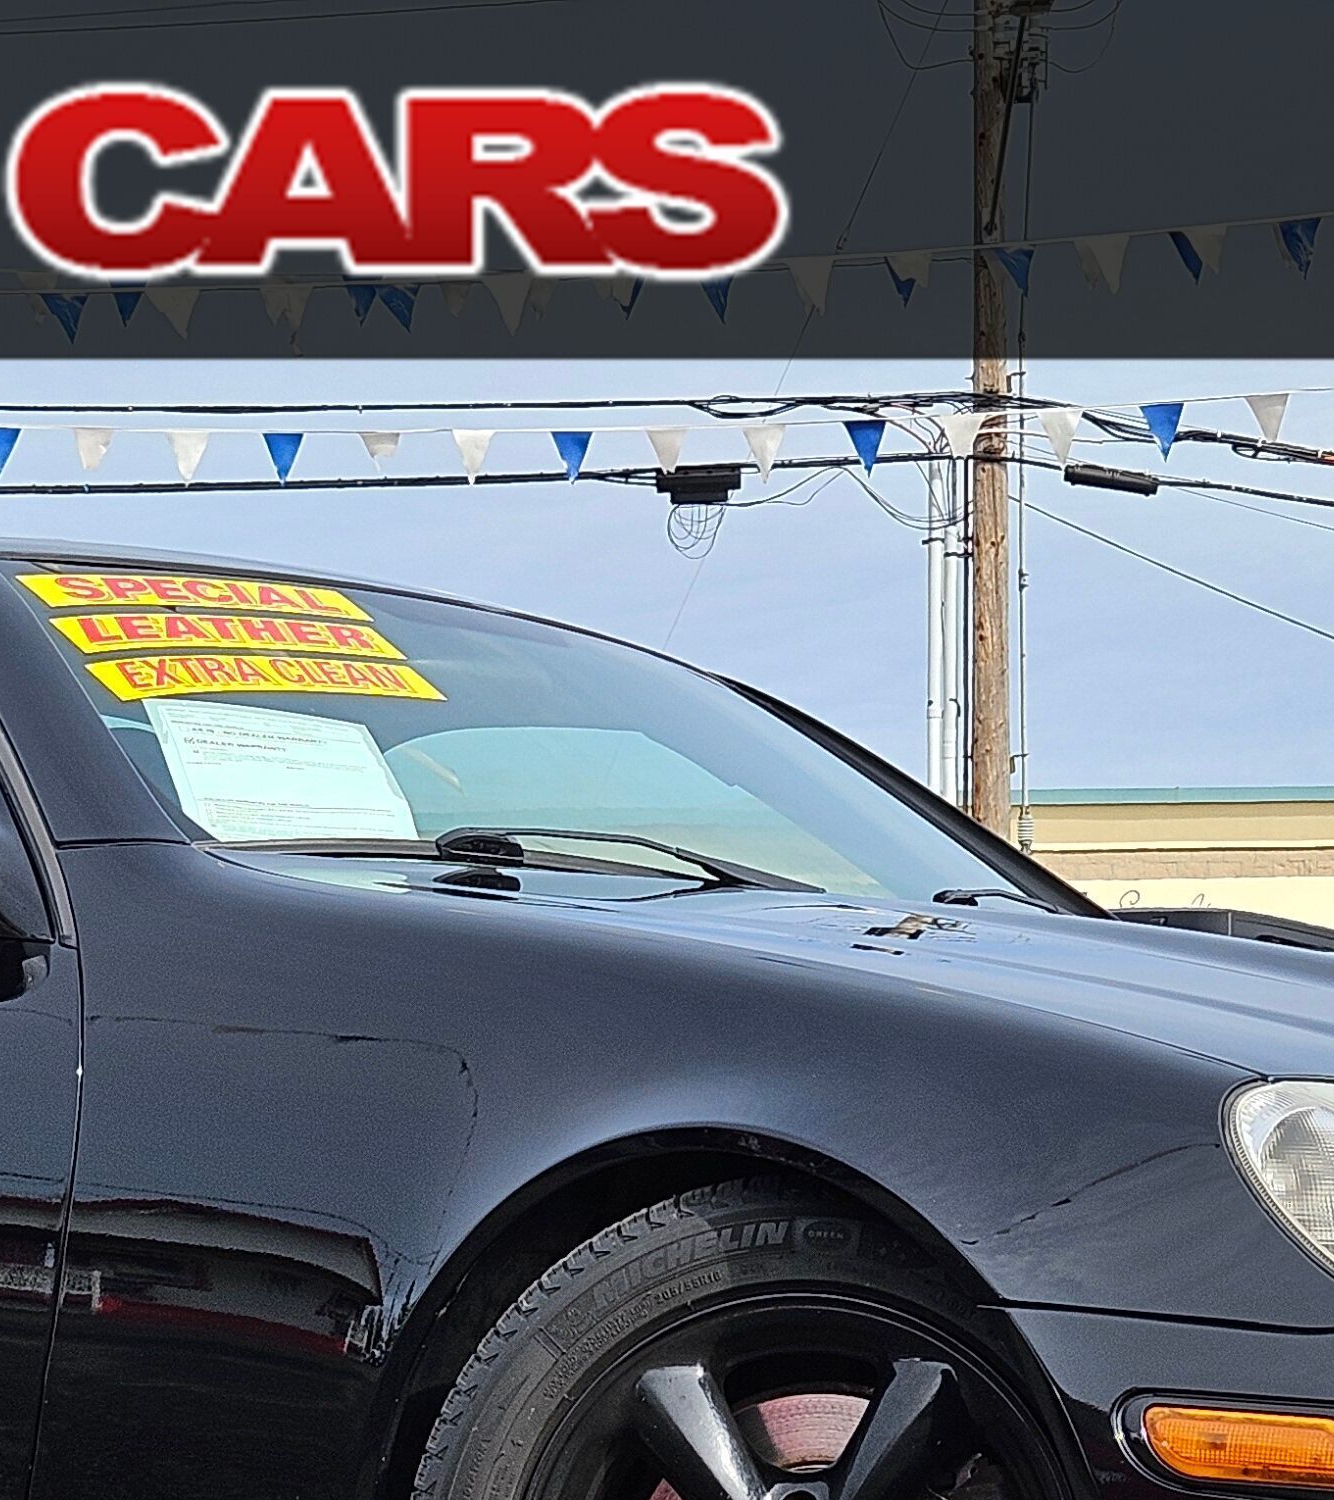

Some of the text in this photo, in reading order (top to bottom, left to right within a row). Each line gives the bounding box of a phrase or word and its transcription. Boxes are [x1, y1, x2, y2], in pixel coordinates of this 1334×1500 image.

[54, 575, 349, 616] SPECIAL
[76, 615, 384, 653] LEATHER
[118, 656, 411, 692] EXTRA CLEAN
[591, 1219, 785, 1307] MICHELIN
